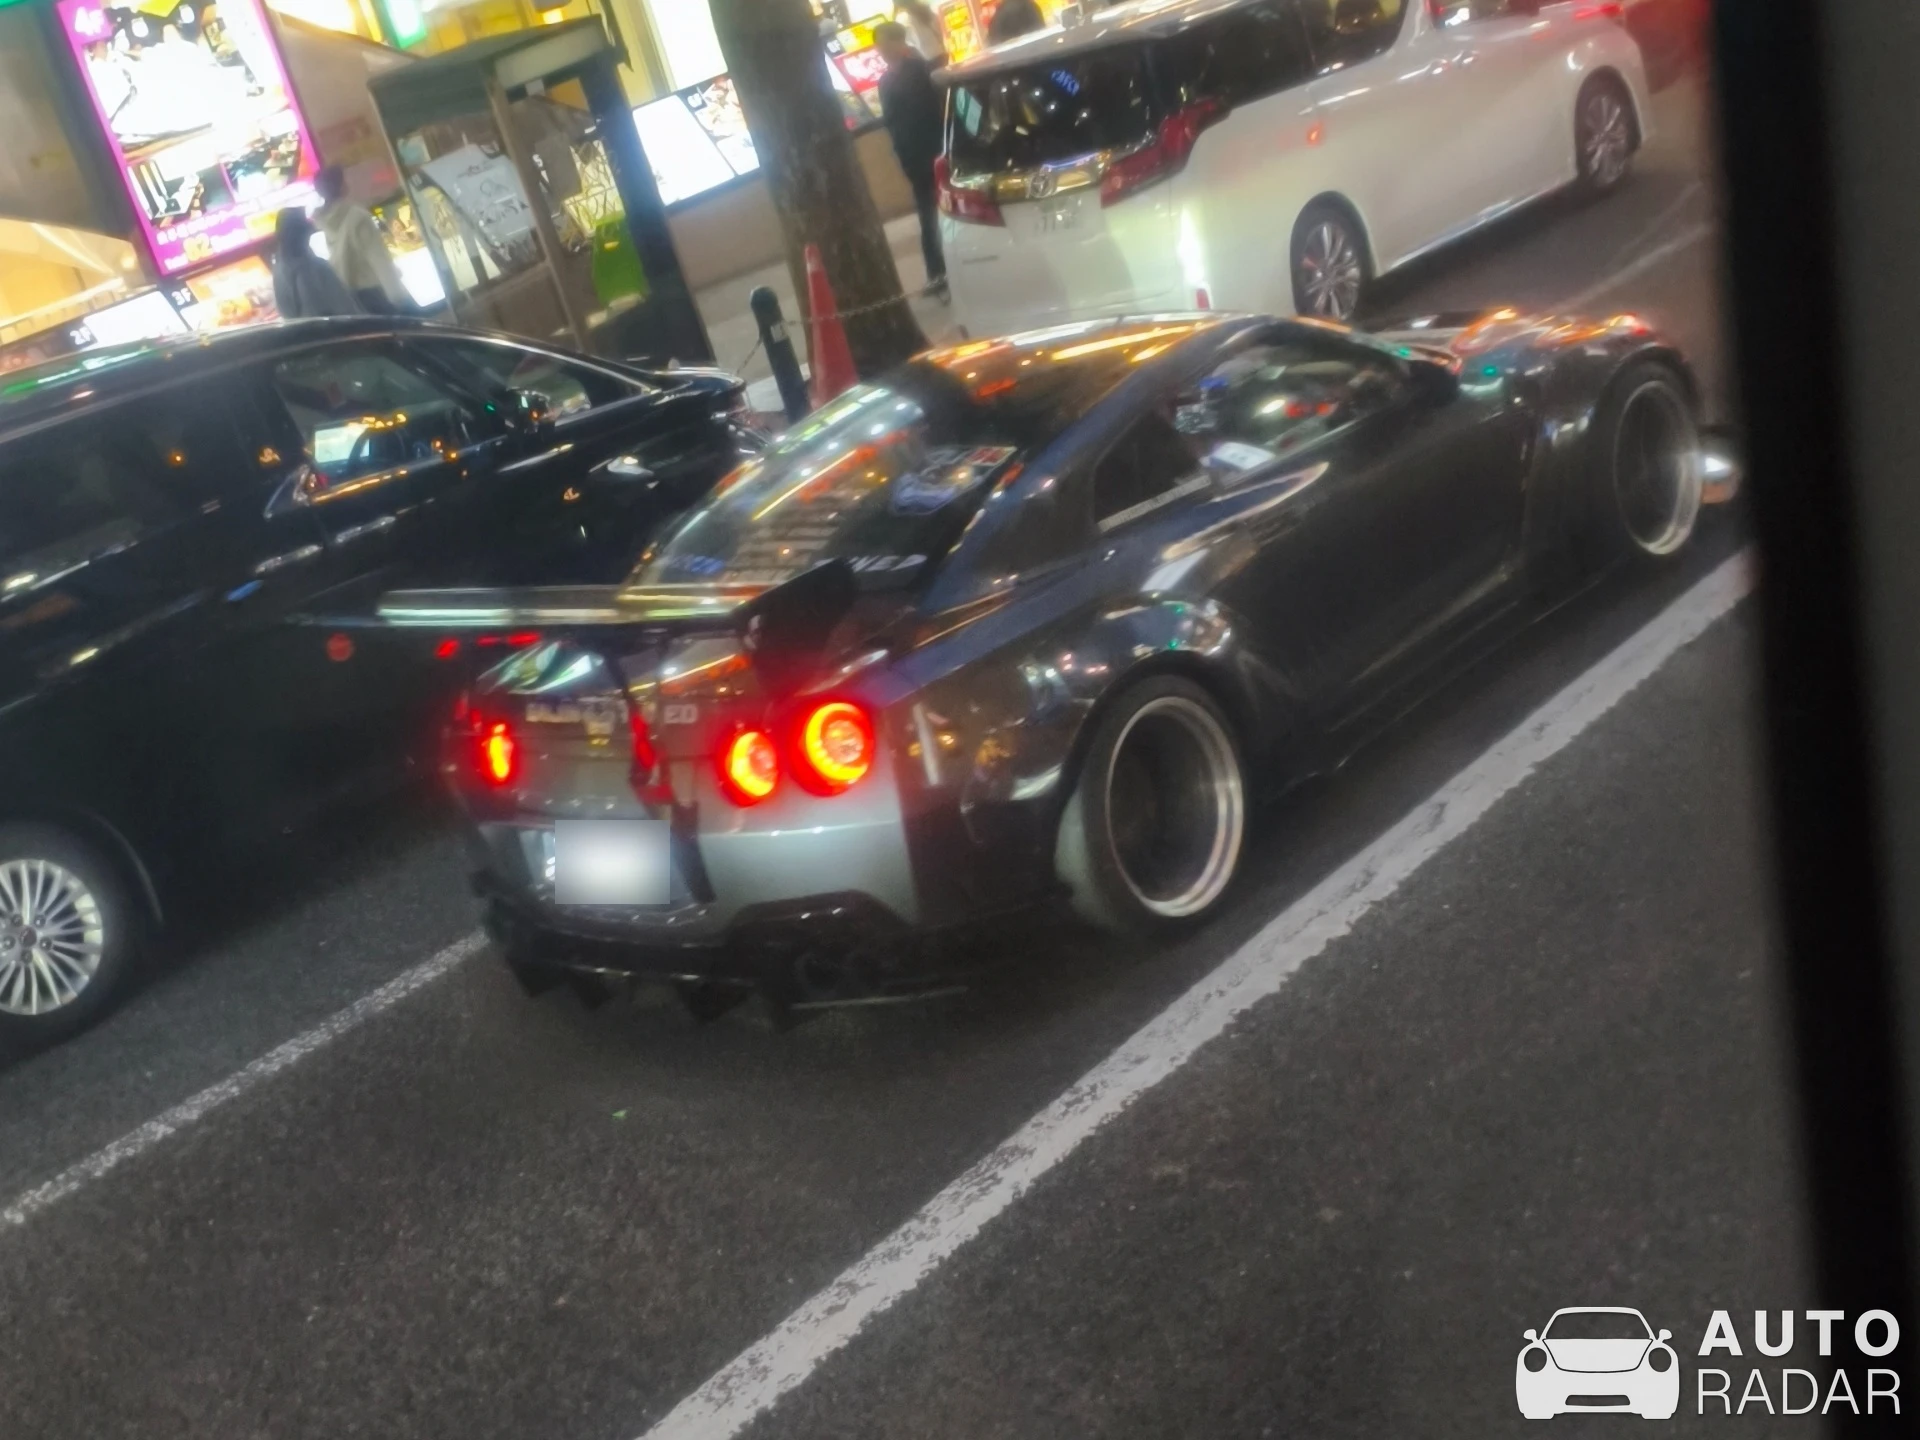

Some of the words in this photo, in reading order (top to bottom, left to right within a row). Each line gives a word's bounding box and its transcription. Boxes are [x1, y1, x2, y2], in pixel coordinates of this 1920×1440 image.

[75, 6, 105, 36] 4F
[171, 287, 193, 306] 3F
[69, 326, 93, 346] 2F
